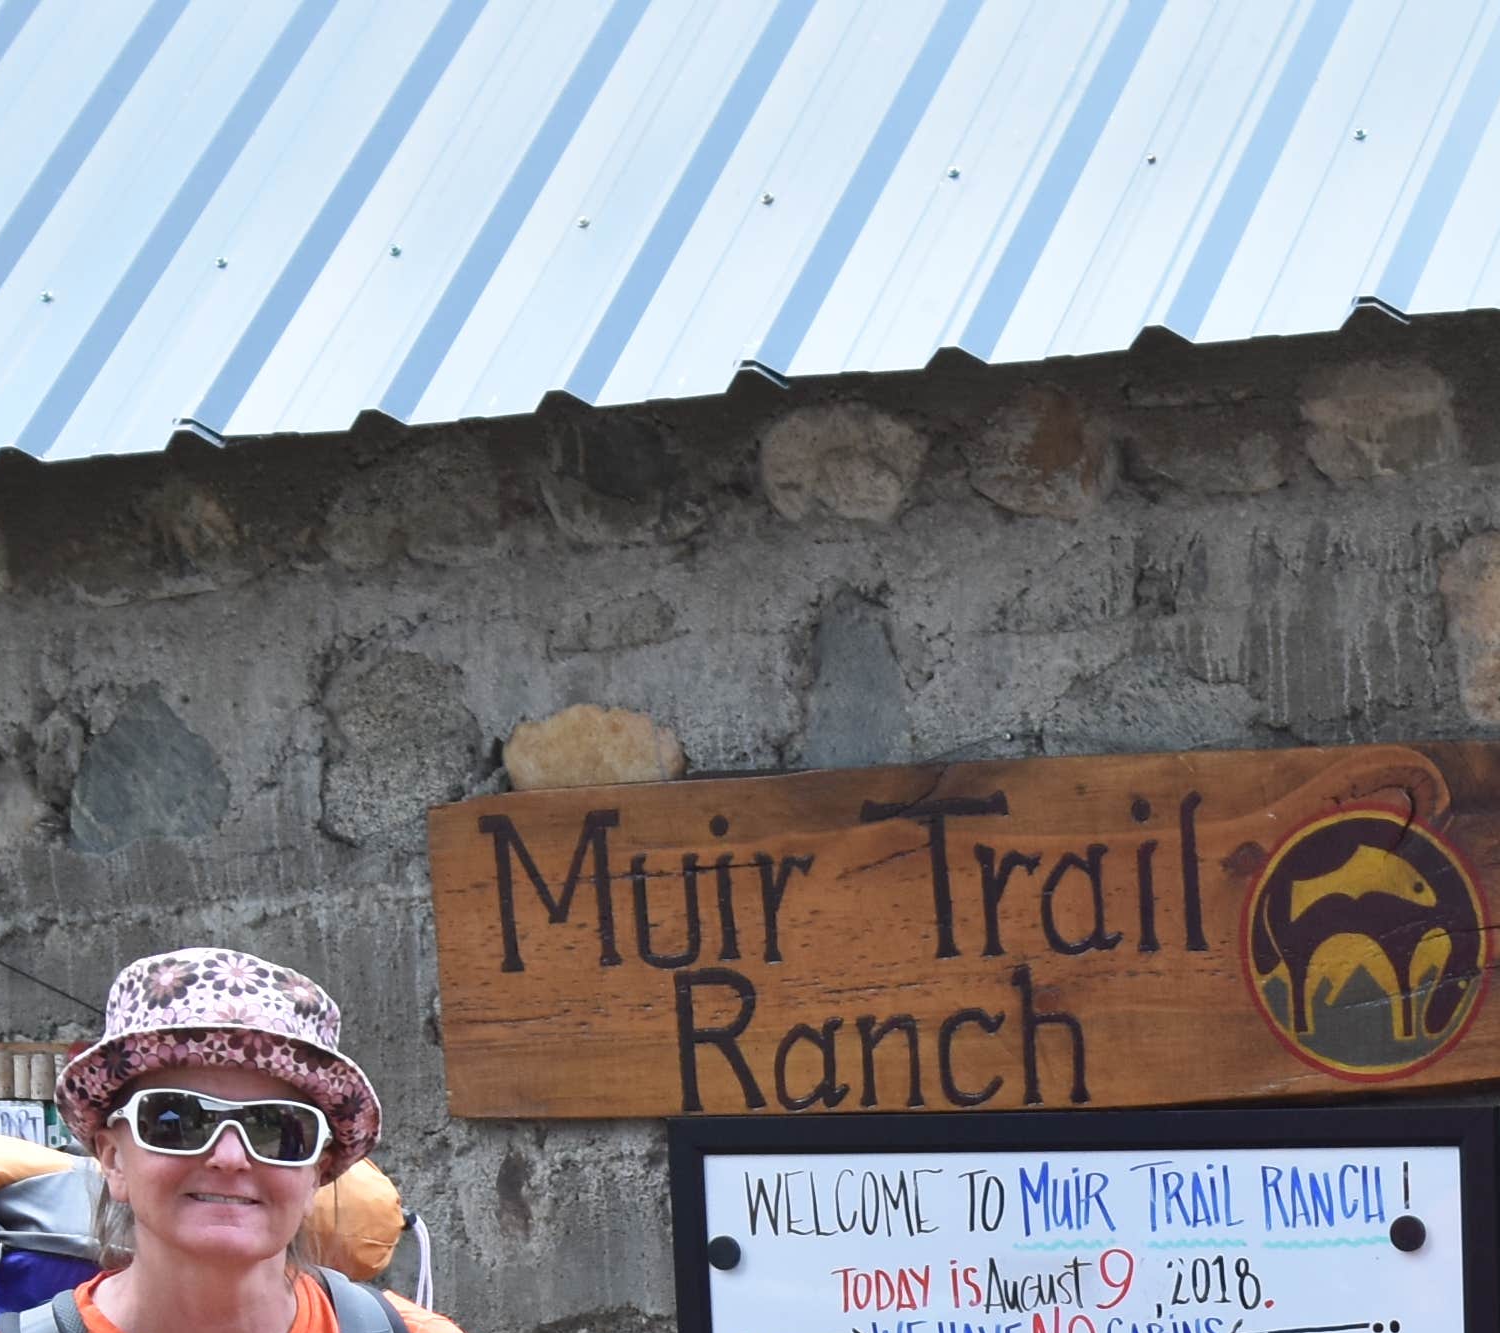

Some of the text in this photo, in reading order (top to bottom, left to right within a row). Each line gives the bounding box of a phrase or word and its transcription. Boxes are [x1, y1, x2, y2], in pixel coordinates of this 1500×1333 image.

[479, 791, 1208, 972] Muir Trail
[673, 964, 1091, 1113] Ranch
[745, 1169, 943, 1236] WELCOME
[958, 1169, 1005, 1232] TO
[832, 1265, 930, 1312] TODAY
